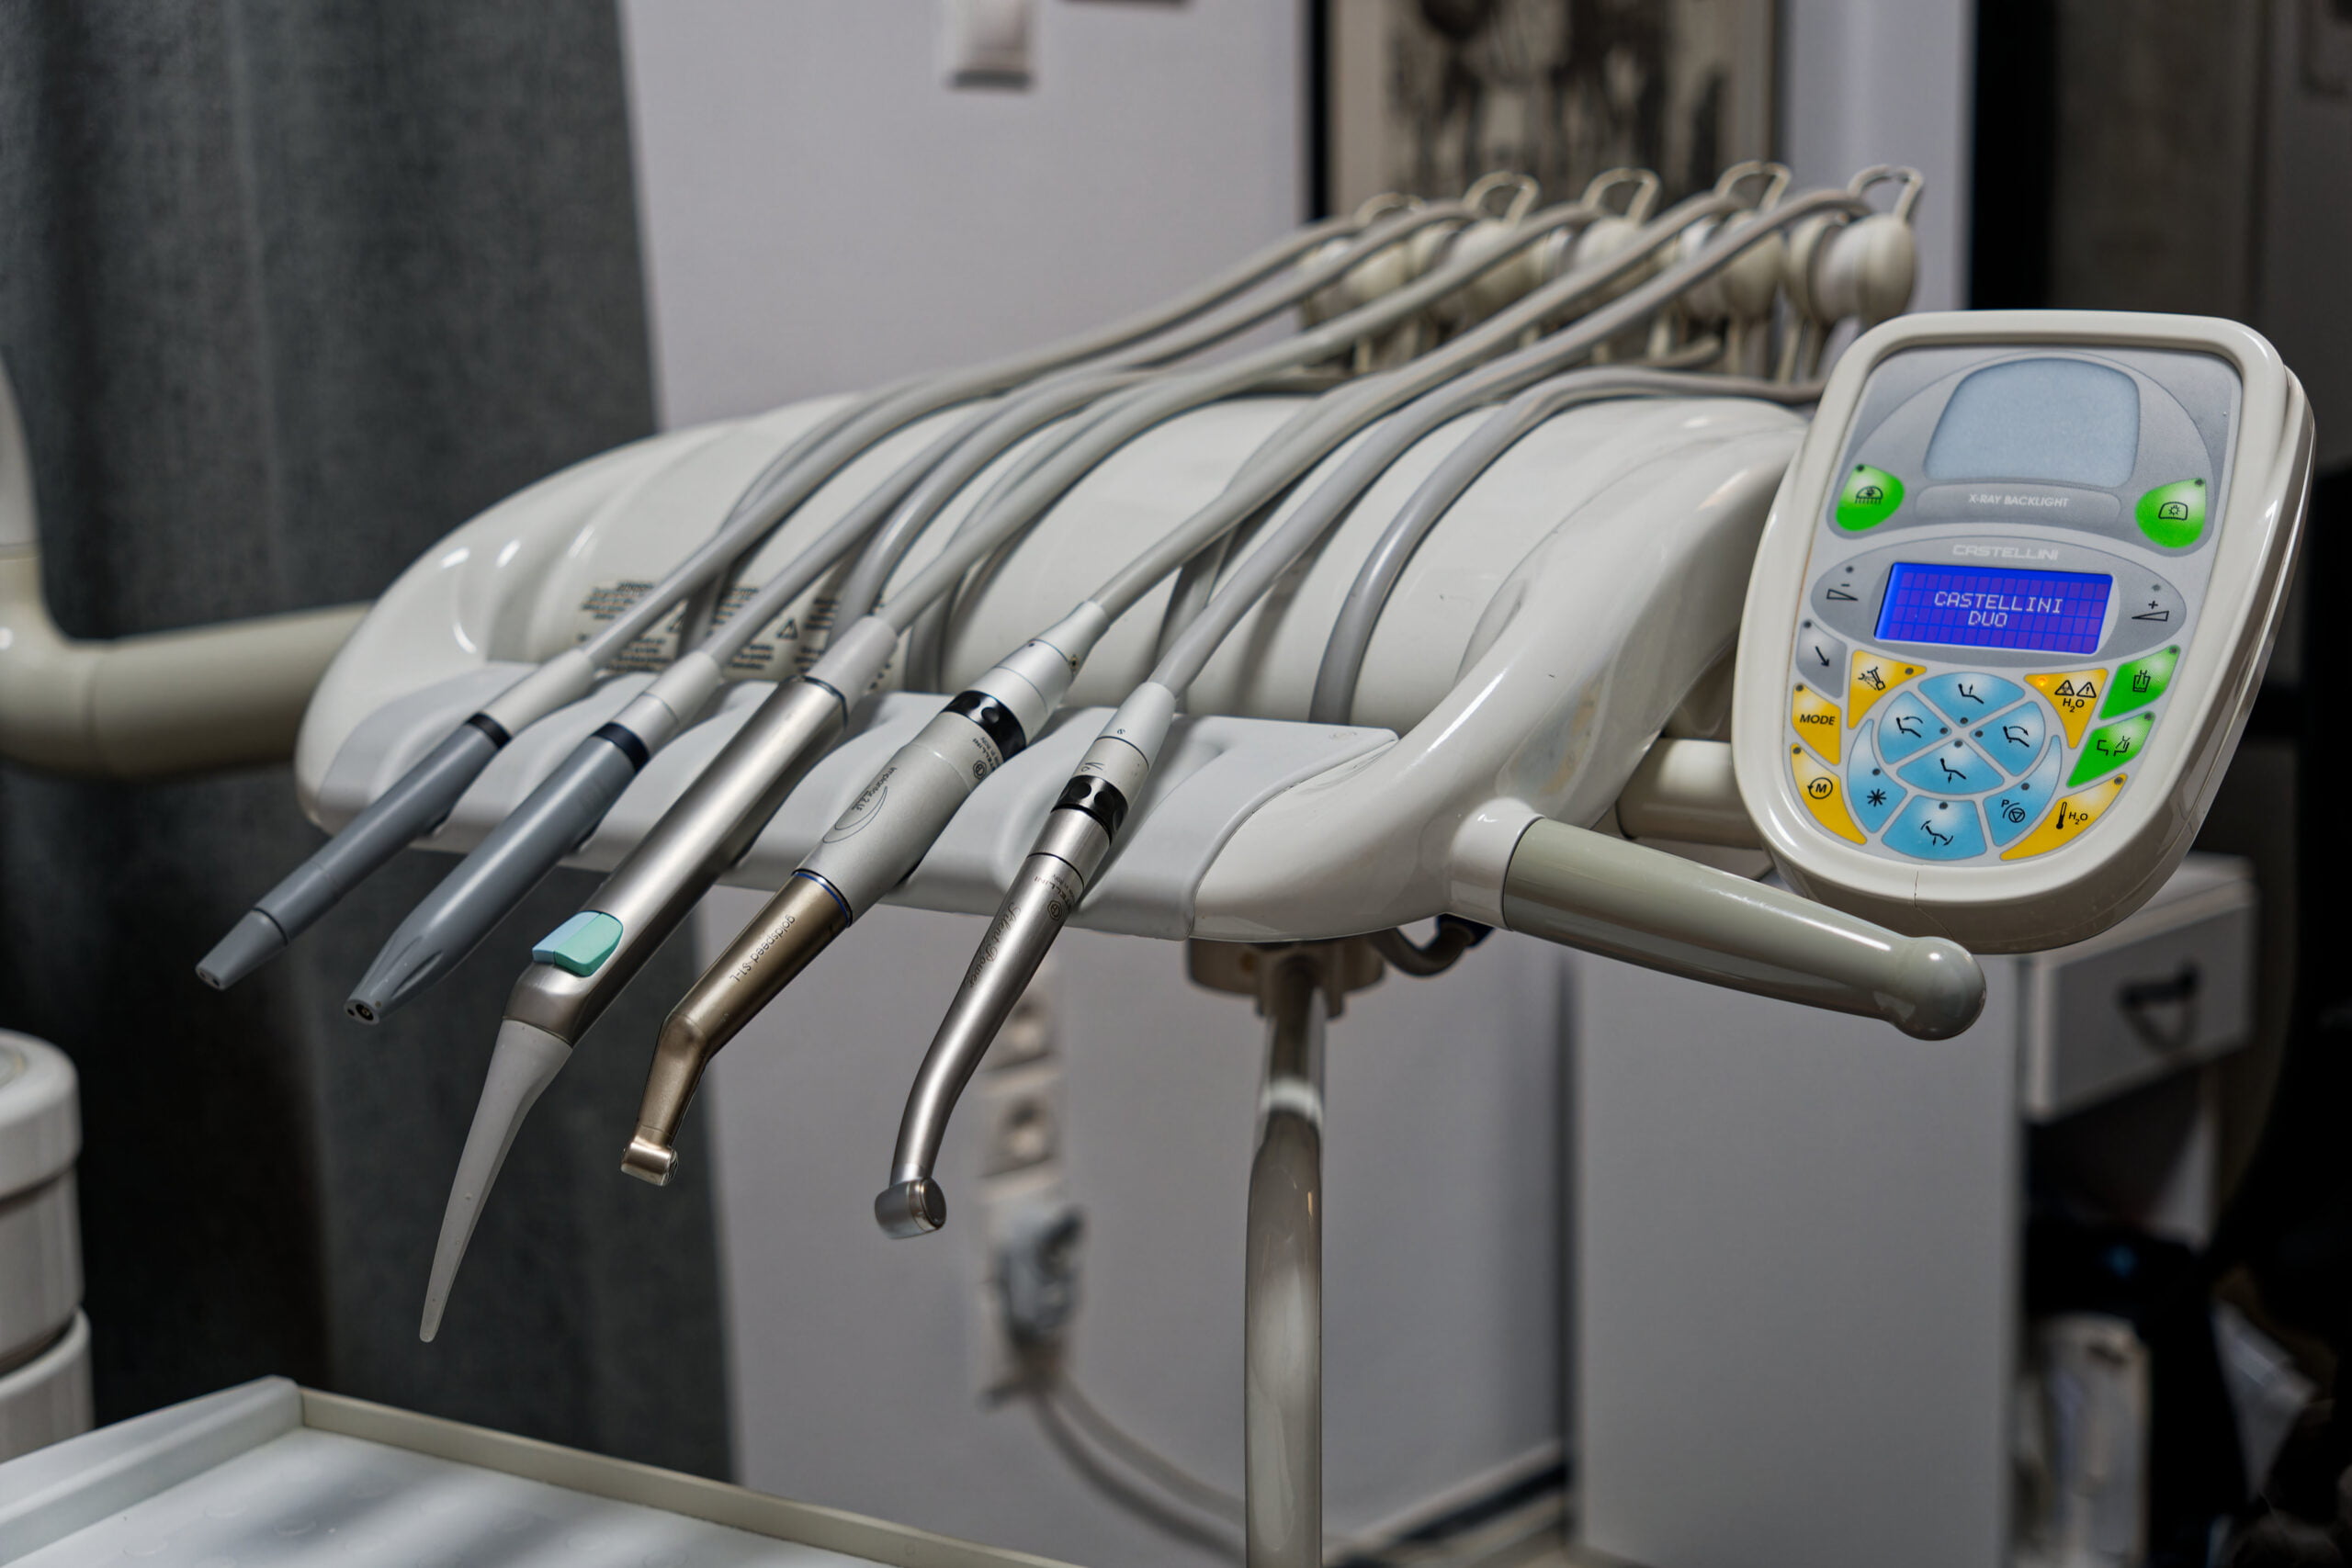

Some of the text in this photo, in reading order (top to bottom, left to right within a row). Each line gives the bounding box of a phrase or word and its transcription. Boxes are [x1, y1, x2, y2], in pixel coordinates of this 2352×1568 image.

[1969, 493, 2069, 507] X-RAY BACKLIGHT
[1952, 544, 2059, 560] CASTELLINI
[1934, 591, 2064, 614] CASTELLINI
[1968, 610, 2008, 627] DUO
[1800, 714, 1836, 726] MODE
[1815, 783, 1827, 794] M
[2001, 799, 2009, 807] P
[750, 915, 796, 963] goldspeed
[969, 943, 998, 987] Power
